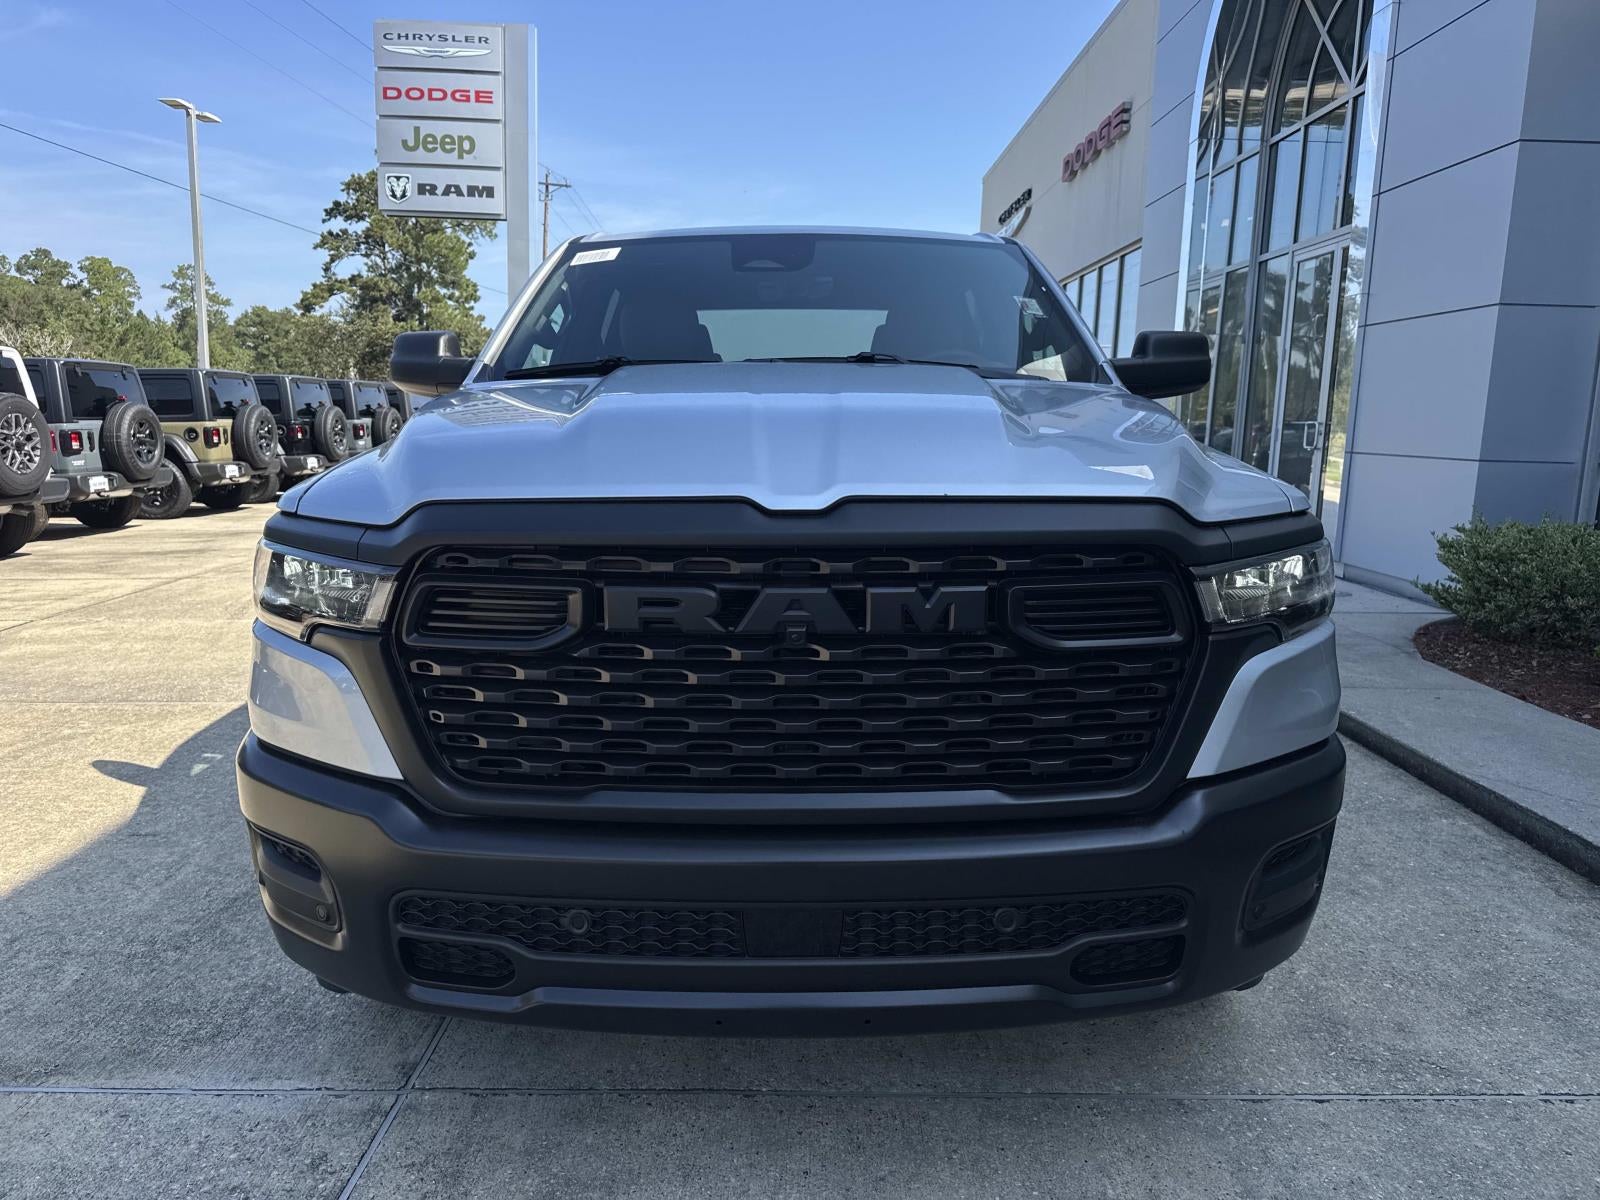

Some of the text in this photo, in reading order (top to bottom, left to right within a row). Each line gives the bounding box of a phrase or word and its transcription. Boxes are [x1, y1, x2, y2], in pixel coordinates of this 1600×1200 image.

[382, 32, 490, 44] CHRYSLER
[382, 86, 494, 104] DODGE
[401, 126, 476, 160] Jeep
[1061, 101, 1132, 183] DODGE
[416, 183, 494, 198] RAM
[604, 585, 988, 633] RAM
